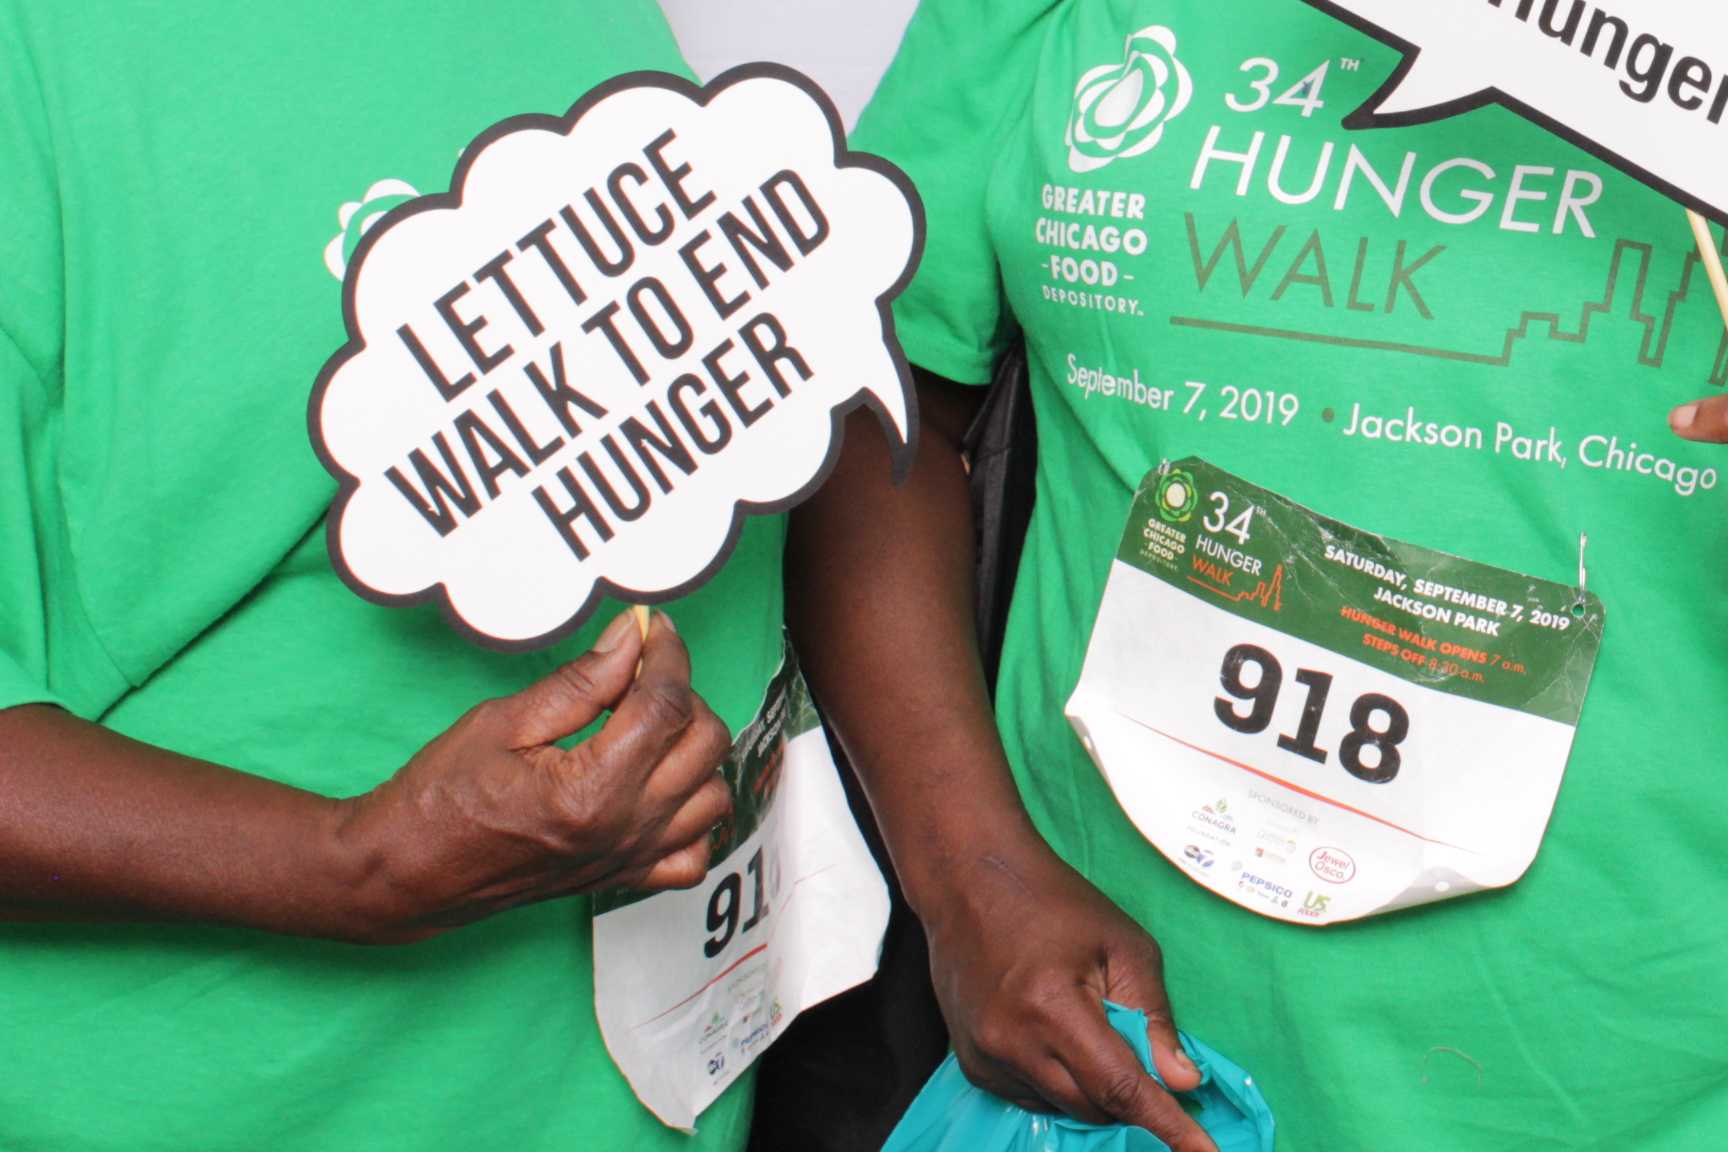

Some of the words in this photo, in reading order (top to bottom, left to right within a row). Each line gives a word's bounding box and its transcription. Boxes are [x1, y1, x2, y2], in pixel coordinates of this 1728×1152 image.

[1041, 184, 1146, 219] GREATER
[1189, 125, 1603, 239] HUNGER
[1035, 217, 1148, 256] CHICAGO
[396, 128, 717, 403] LETTUCE
[1183, 212, 1448, 321] WALK
[384, 341, 609, 538] WALK
[581, 276, 694, 387] TO
[677, 169, 830, 320] END
[531, 312, 815, 562] HUNGER
[1067, 353, 1174, 412] September
[1183, 382, 1207, 421] 7,
[1219, 384, 1299, 427] 2019
[1343, 403, 1483, 449] Jackson
[1495, 422, 1567, 470] Park,
[1578, 434, 1717, 496] Chicago
[1143, 528, 1185, 554] CHICAGO
[1148, 518, 1187, 544] GREATER
[1192, 554, 1234, 586] WALK
[1195, 534, 1262, 576] HUNGER
[1324, 545, 1408, 590] SATURDAY,
[1413, 578, 1506, 616] SEPTEMBER
[1508, 604, 1525, 622] 7,
[1529, 610, 1571, 631] 2019
[1374, 586, 1451, 623] JACKSON
[1453, 611, 1500, 637] PARK
[1341, 605, 1396, 636] HUNGER
[1398, 627, 1438, 651] WALK
[1439, 642, 1487, 664] OPENS
[1489, 654, 1502, 666] 7
[1362, 633, 1399, 657] STEPS
[1400, 648, 1427, 666] OFF
[1428, 657, 1459, 676] 8:30
[1214, 643, 1410, 784] 918
[1192, 811, 1237, 835] CONAGRA
[1248, 789, 1306, 820] SPONSORED
[1316, 851, 1351, 870] Jewel
[1241, 872, 1293, 898] PEPSICO
